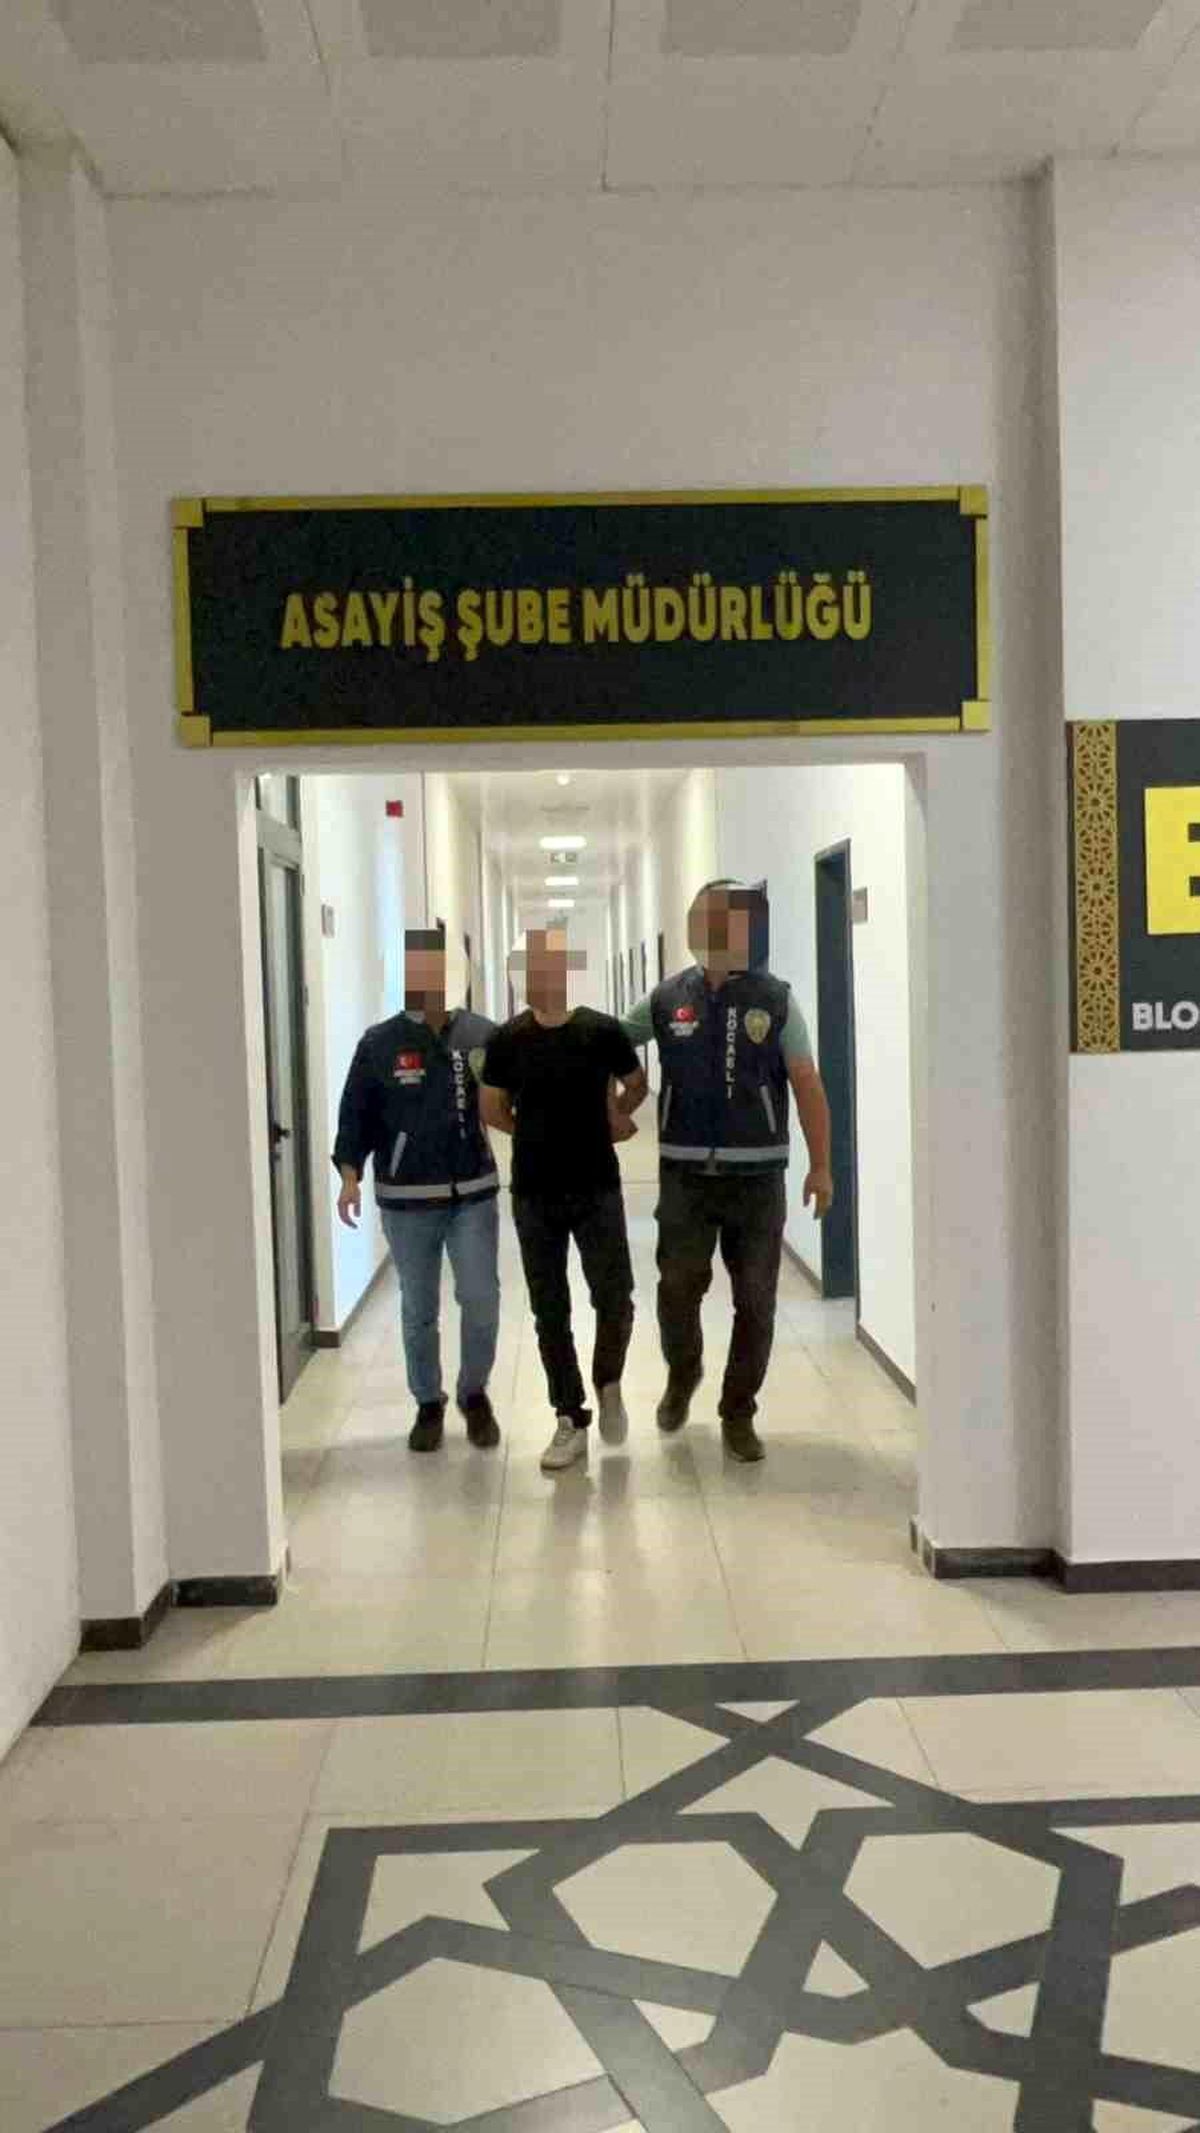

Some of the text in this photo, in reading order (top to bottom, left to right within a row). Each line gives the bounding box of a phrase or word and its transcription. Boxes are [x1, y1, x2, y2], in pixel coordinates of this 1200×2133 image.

[280, 570, 872, 662] ASAYİŞ ŞUBE MÜDÜRLÜĞÜ
